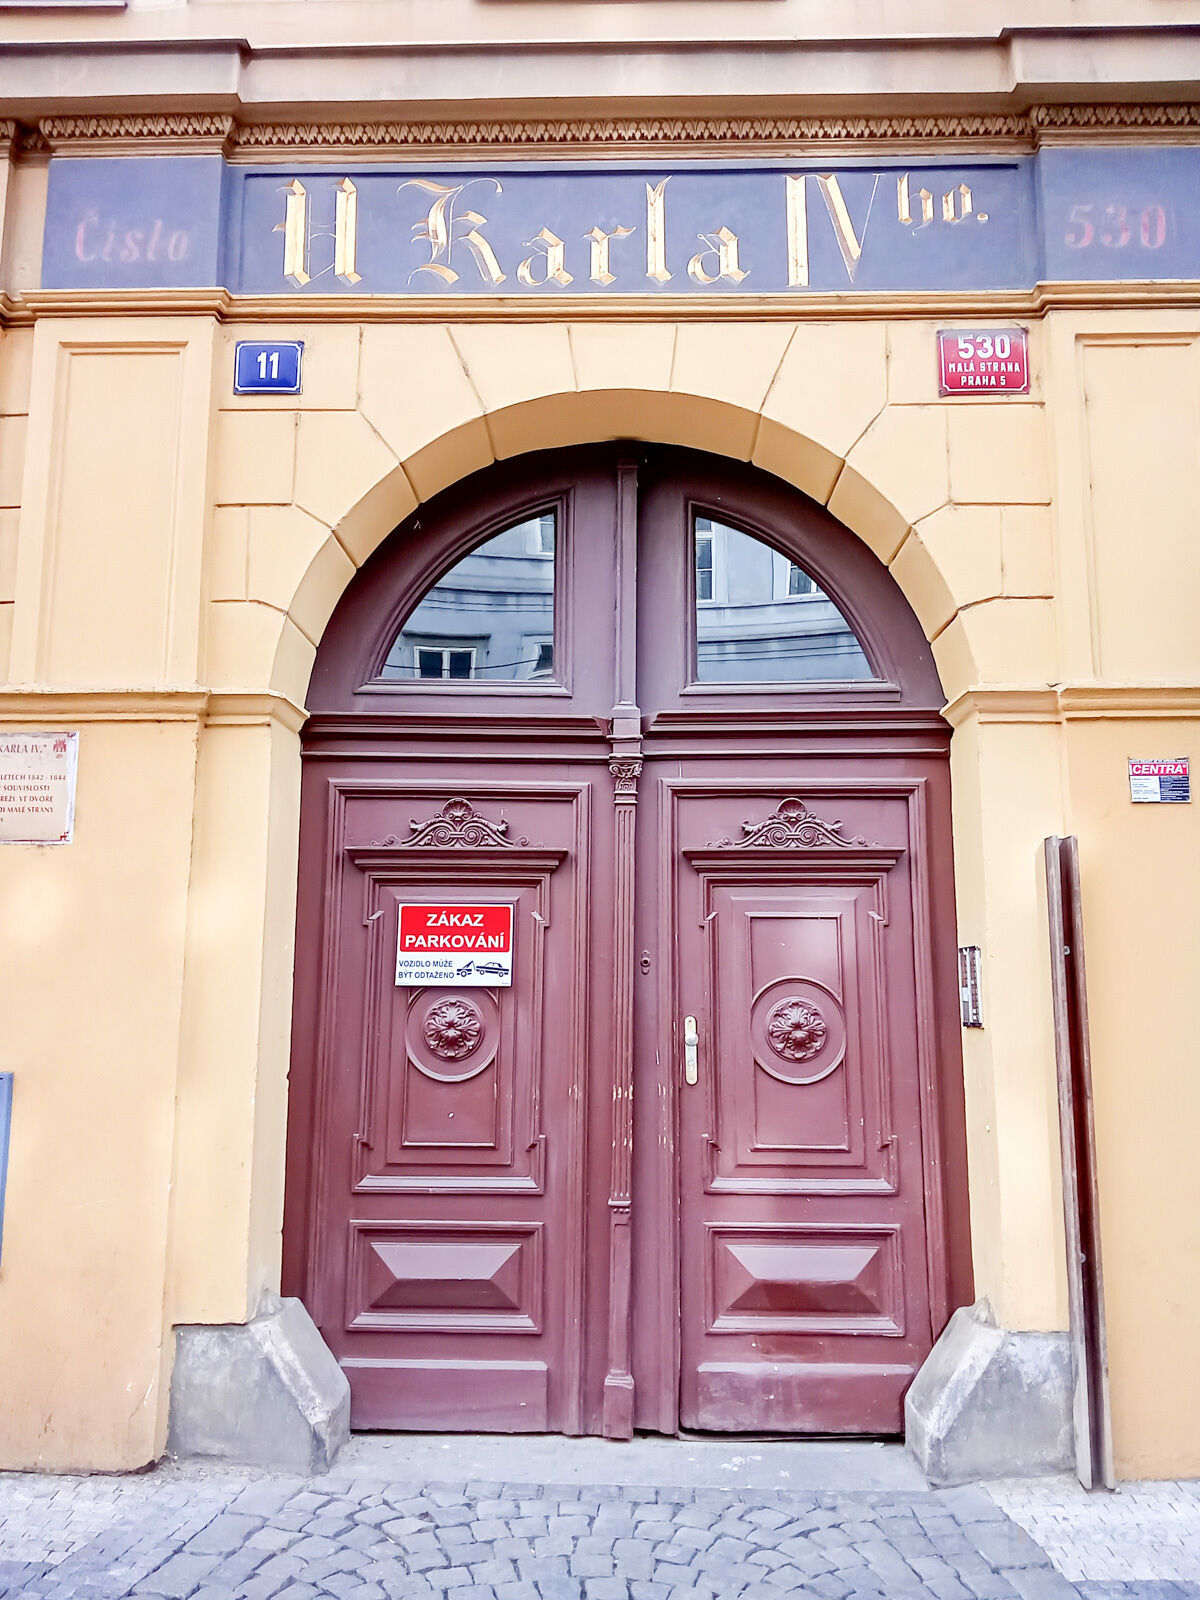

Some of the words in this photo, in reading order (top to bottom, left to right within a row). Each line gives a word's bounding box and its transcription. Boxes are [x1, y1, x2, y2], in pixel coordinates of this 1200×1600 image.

[397, 175, 752, 288] Karla
[1064, 203, 1167, 250] 530
[957, 334, 1011, 359] 530
[257, 351, 280, 379] 11
[948, 360, 975, 373] MALÁ
[980, 362, 1021, 373] STRANA
[961, 375, 997, 386] PRAHA
[1000, 375, 1006, 386] 5
[1132, 764, 1184, 774] CENTRA
[426, 911, 484, 927] ZÁKAZ
[405, 932, 505, 948] PARKOVÁNÍ
[398, 960, 431, 968] VOZIDLO
[432, 958, 453, 968] MŮŽE
[398, 969, 413, 979] BÝT
[414, 970, 455, 979] ODTAŽENO
